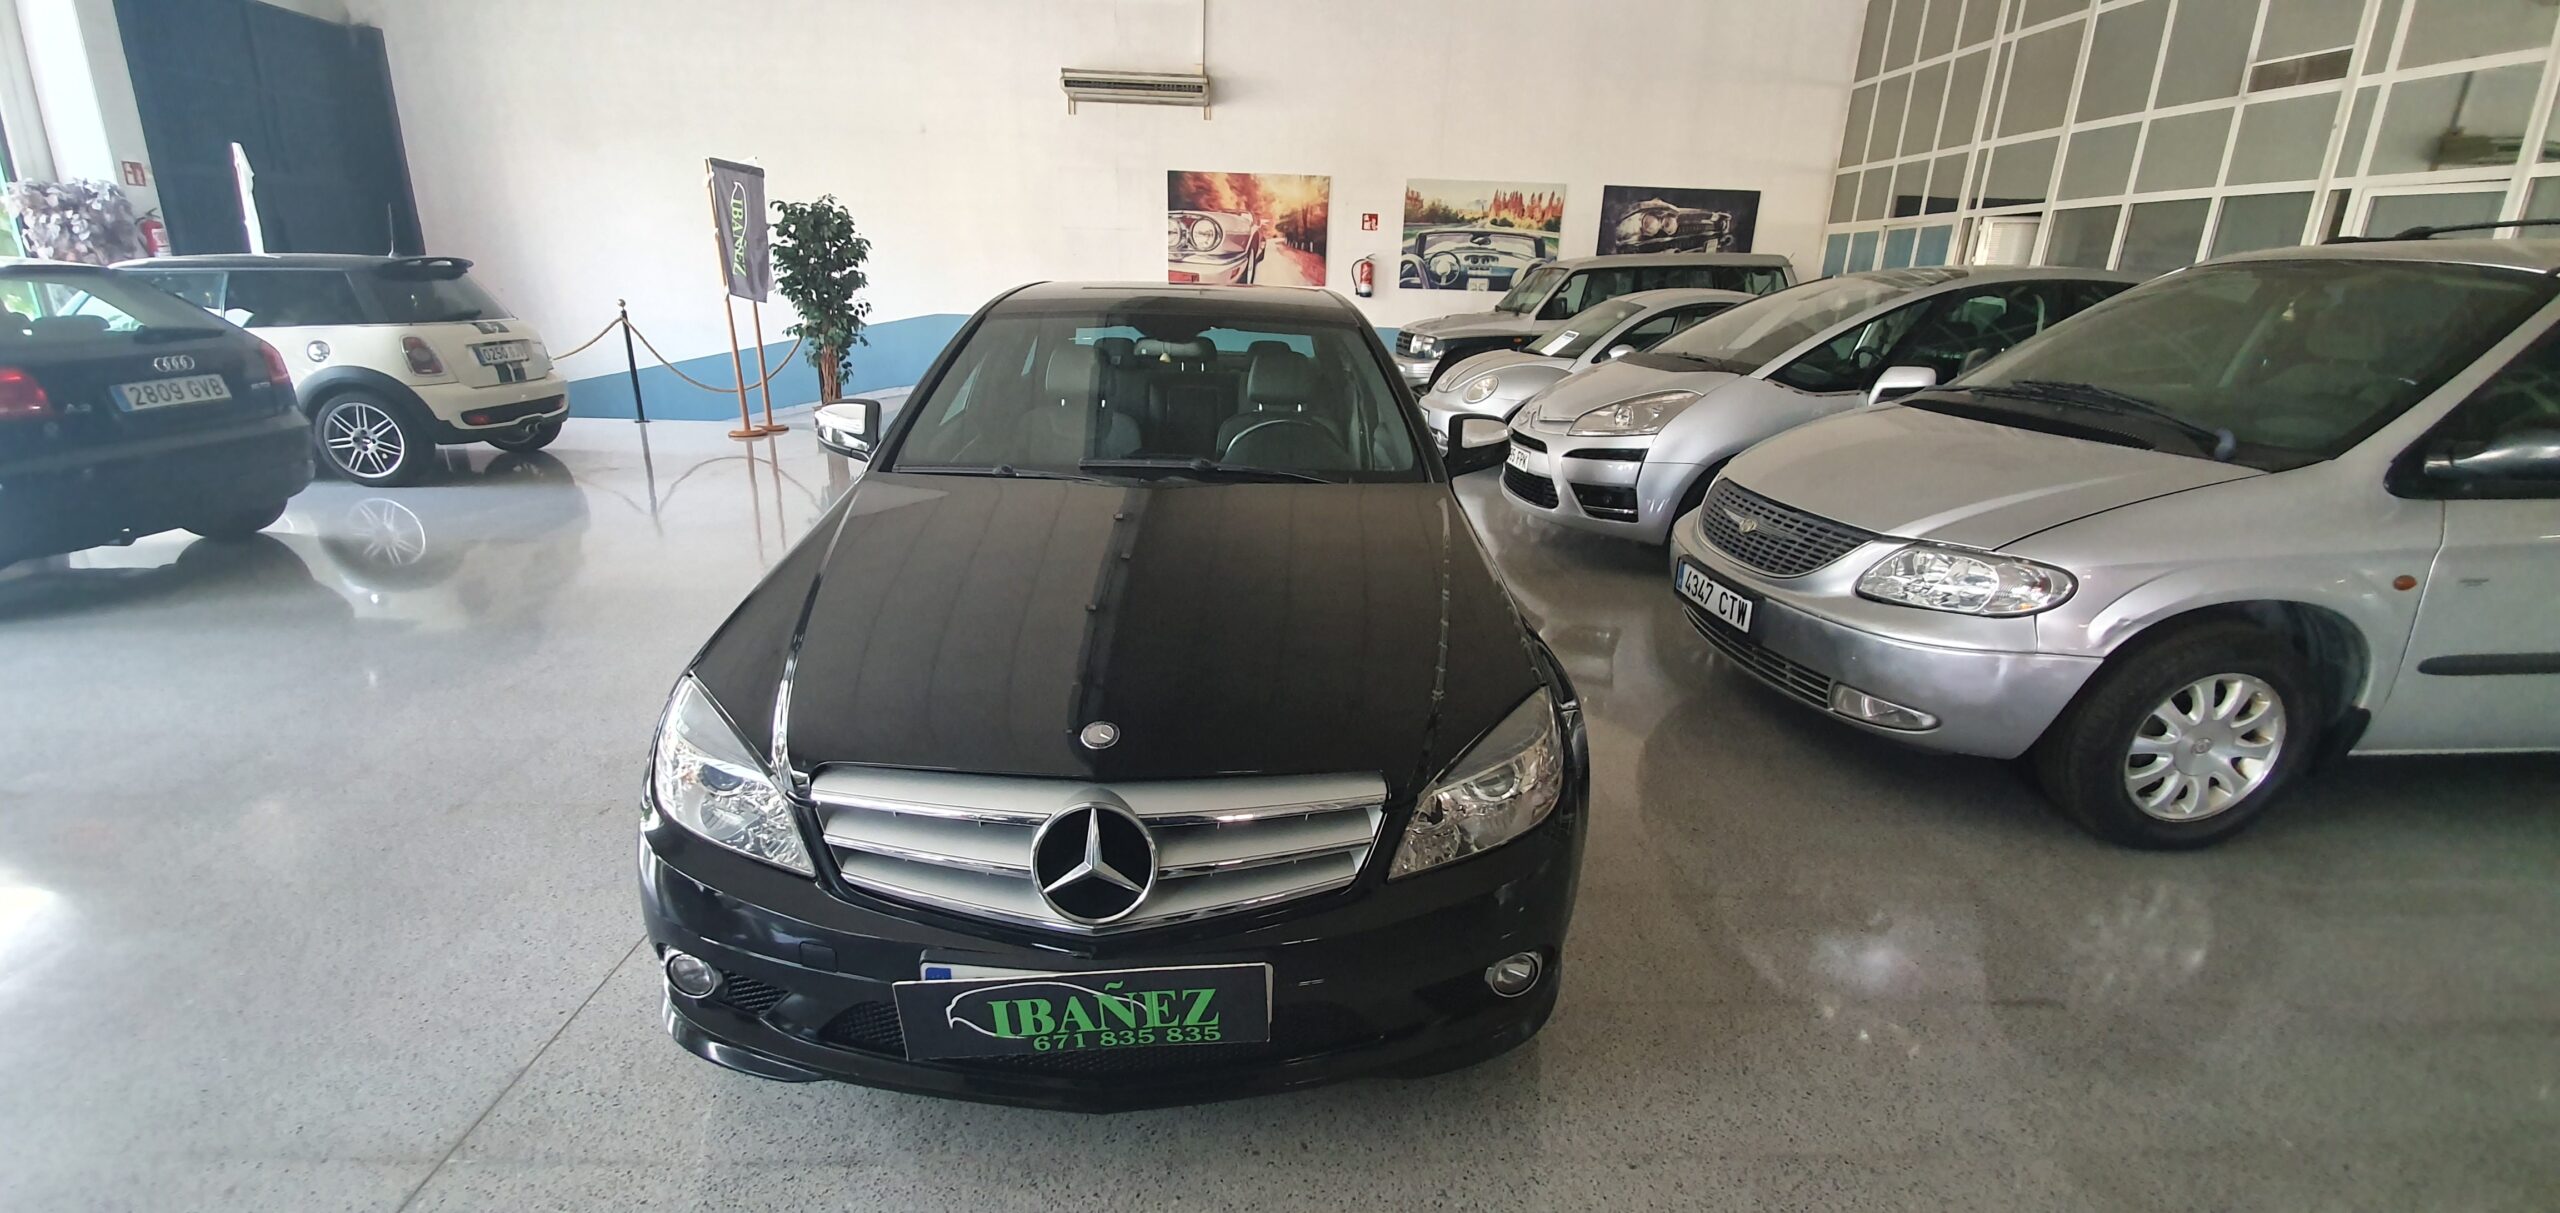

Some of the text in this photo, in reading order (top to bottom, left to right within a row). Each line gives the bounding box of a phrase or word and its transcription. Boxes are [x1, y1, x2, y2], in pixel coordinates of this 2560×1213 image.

[730, 198, 748, 278] IBAÑEZ
[128, 377, 225, 406] 2809 GVB
[1684, 570, 1748, 627] 4347 CTW
[986, 980, 1220, 1038] IBAÑEZ
[1033, 1025, 1222, 1051] 671 835 835
